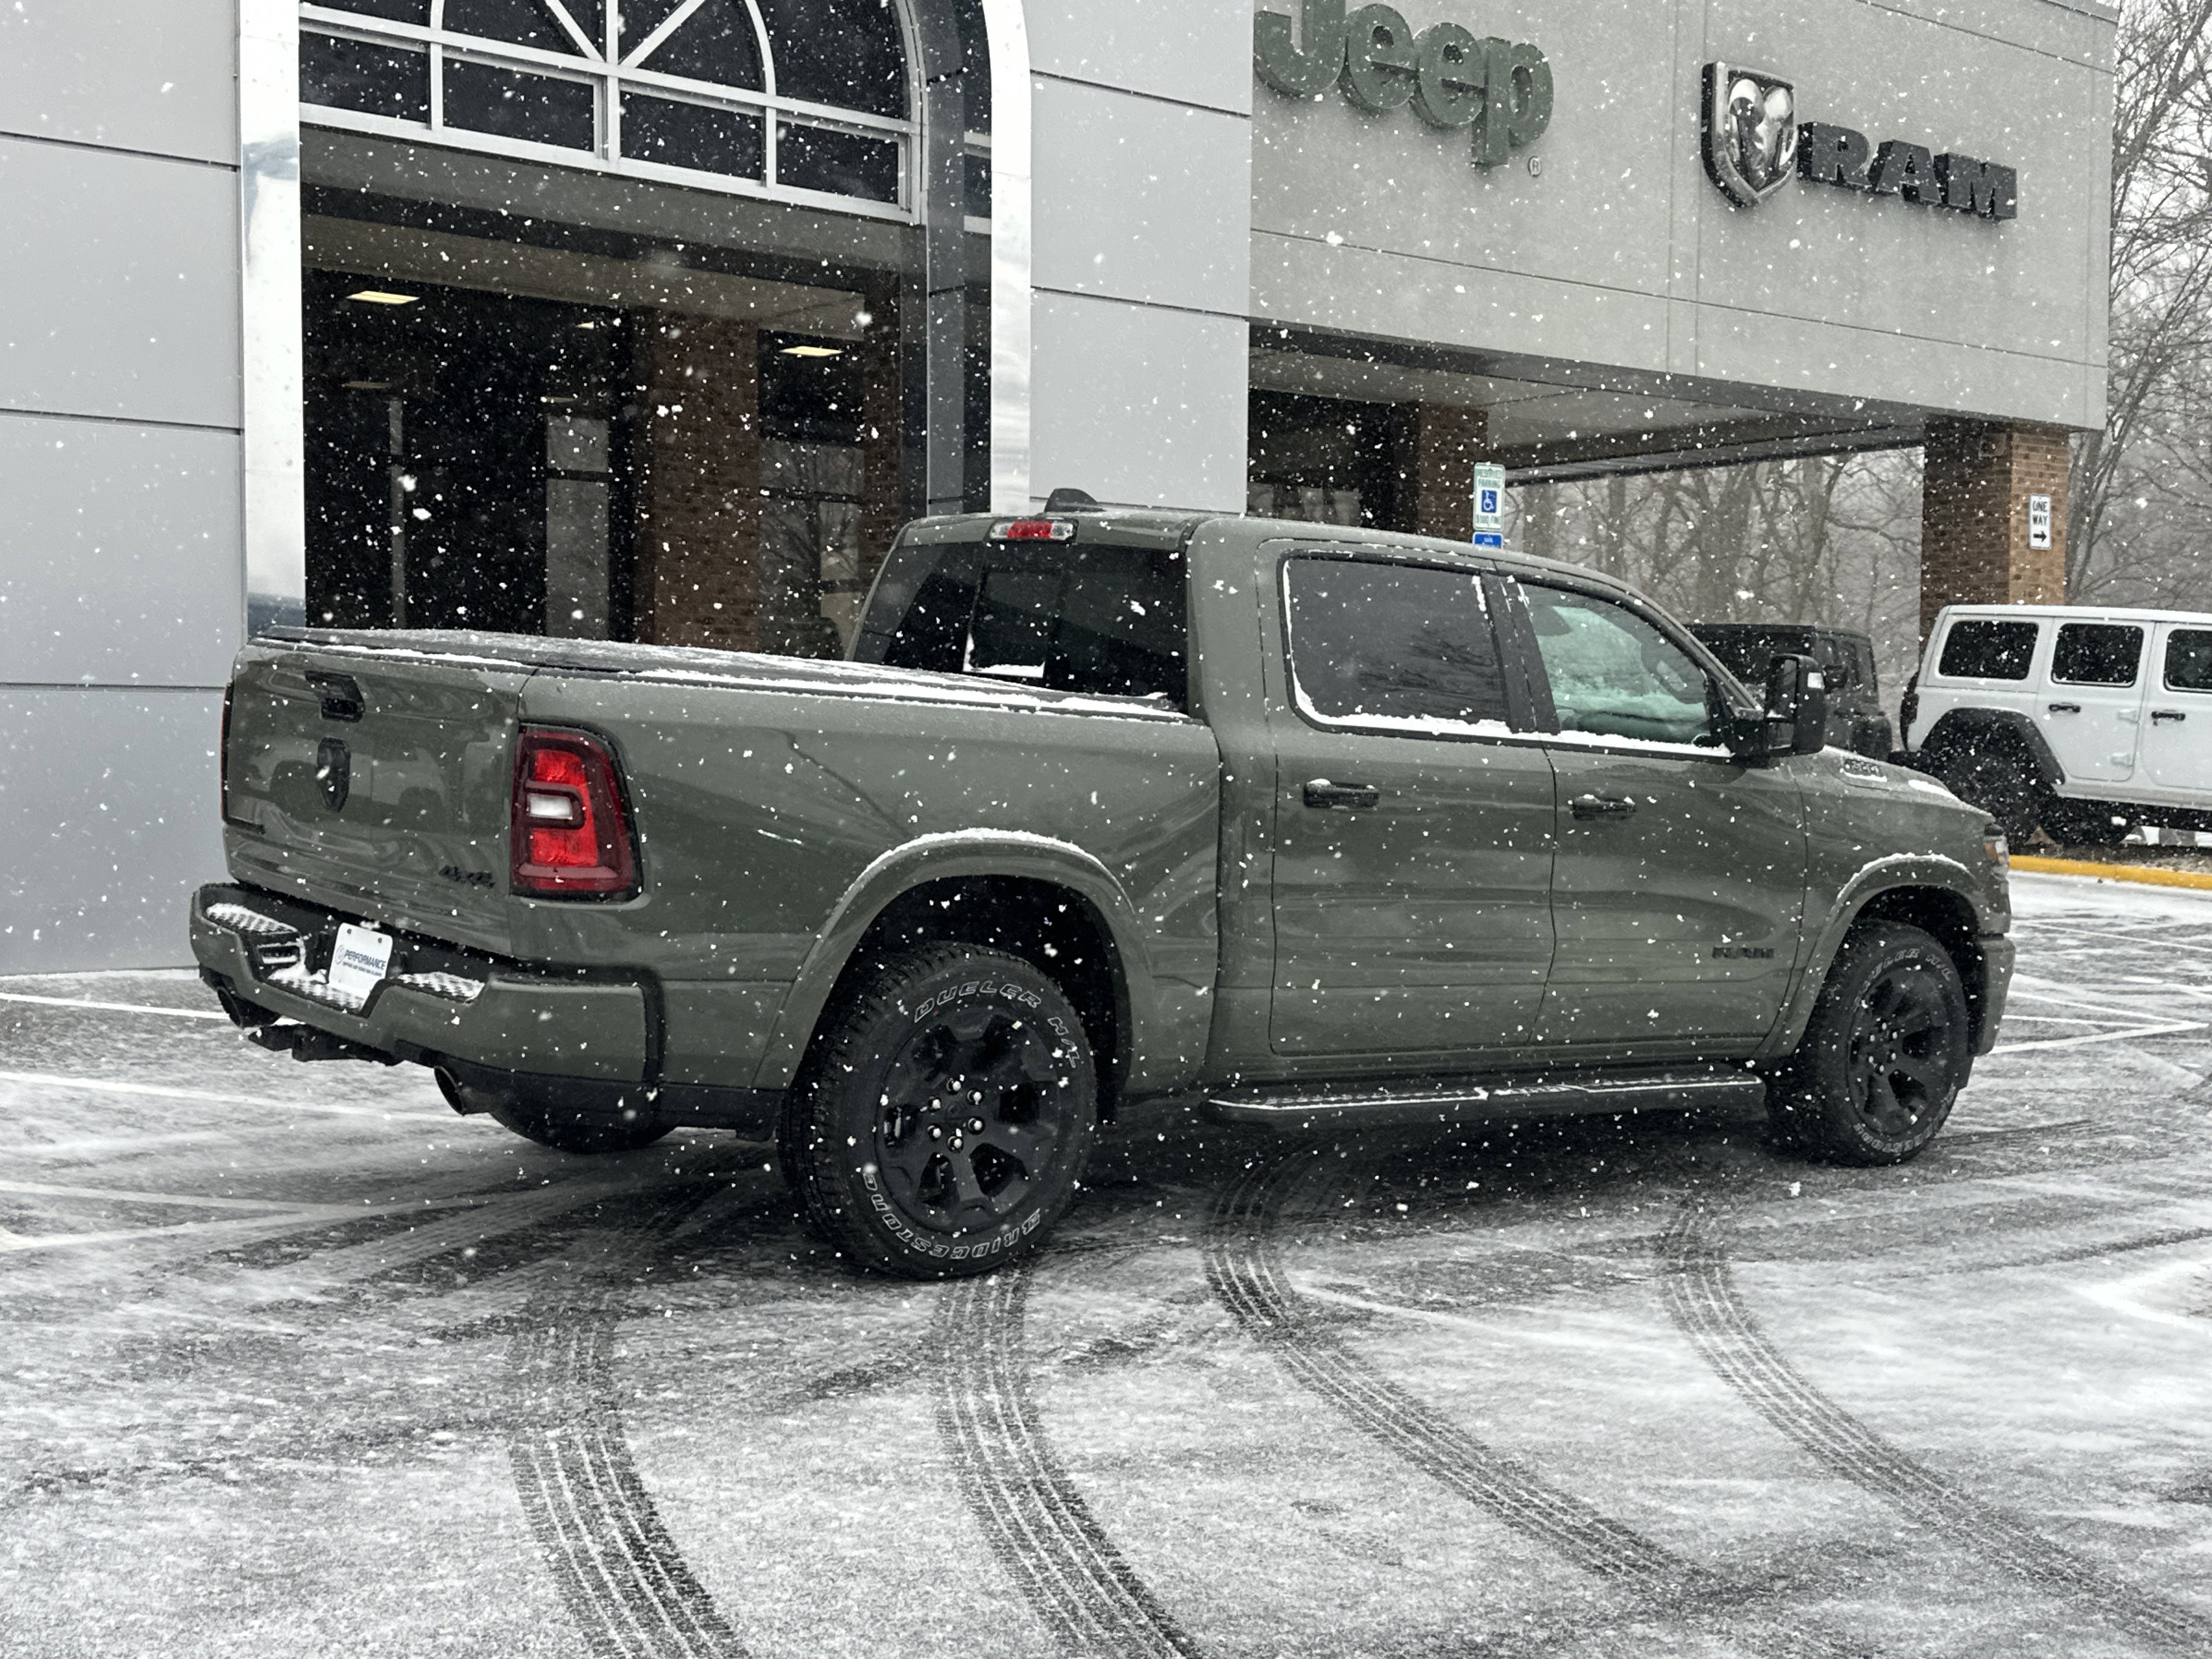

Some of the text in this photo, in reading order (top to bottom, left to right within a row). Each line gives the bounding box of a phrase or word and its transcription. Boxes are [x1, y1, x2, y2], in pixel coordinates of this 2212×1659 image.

[1254, 0, 1554, 166] Jeep
[1797, 121, 2017, 220] RAM
[2032, 500, 2047, 512] ONE
[2032, 514, 2048, 526] WAY
[344, 949, 387, 970] PERFORMANCE
[914, 980, 1041, 1023] DUELER
[862, 1171, 1041, 1260] BRIDGESTONE
